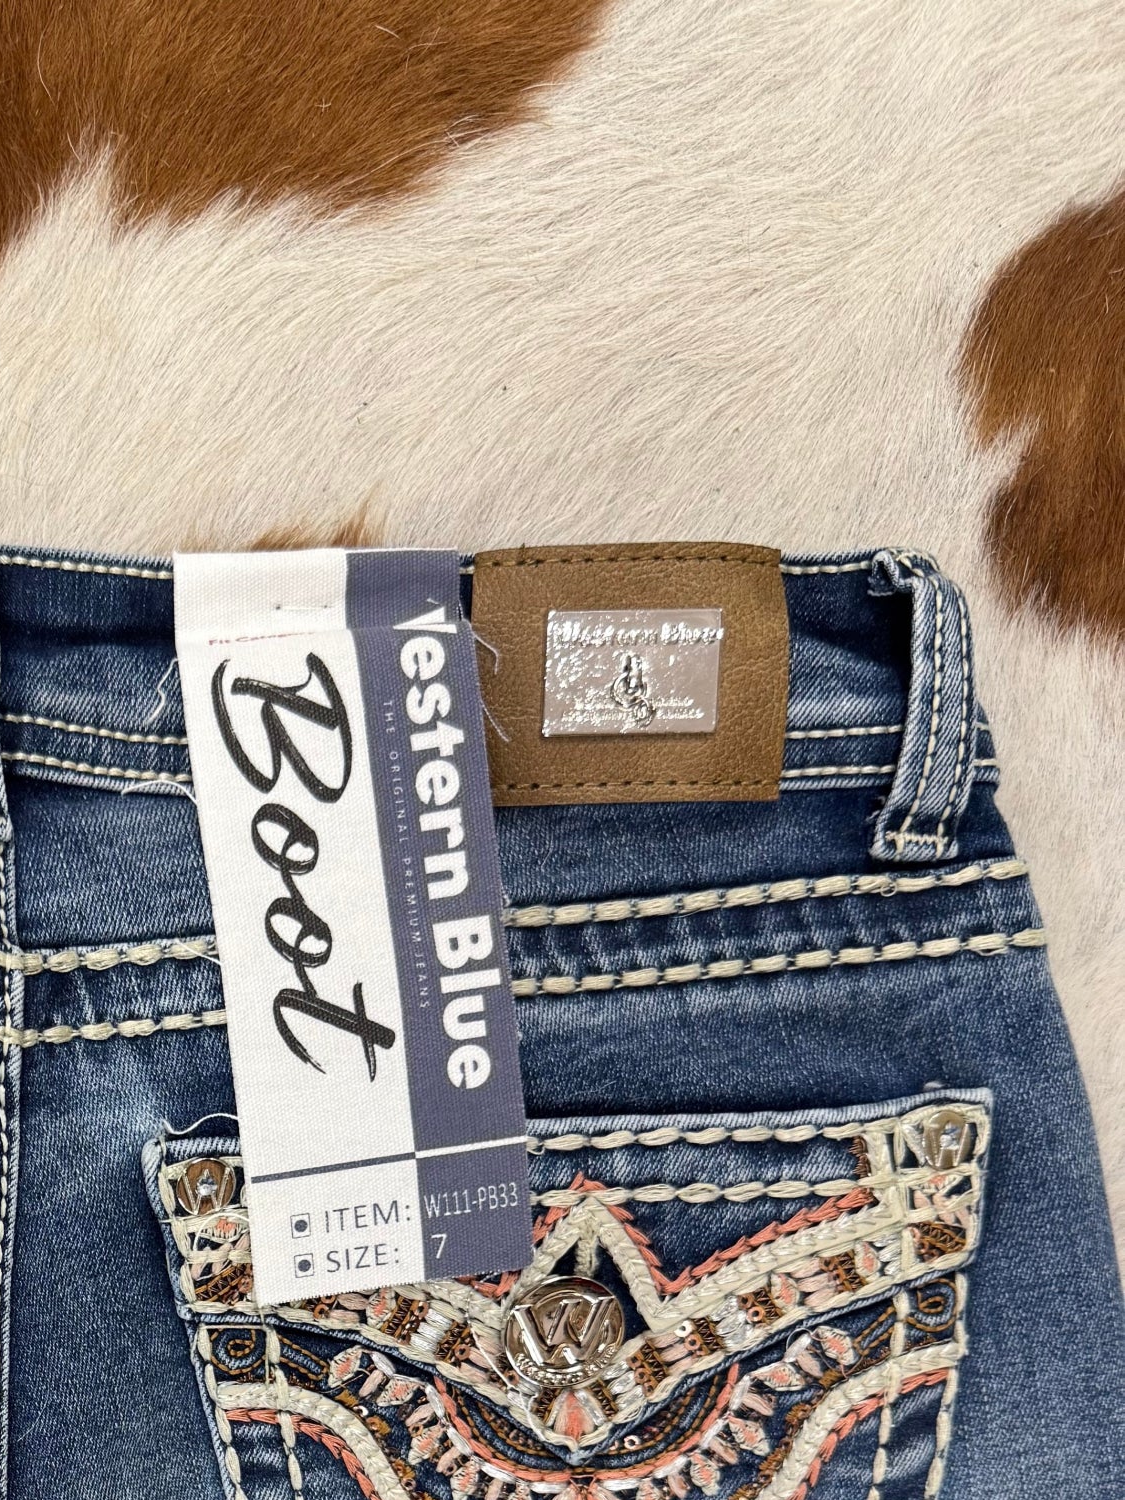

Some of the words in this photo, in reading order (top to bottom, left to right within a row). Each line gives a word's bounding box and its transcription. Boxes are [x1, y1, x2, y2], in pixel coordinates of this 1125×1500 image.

[383, 700, 396, 734] THE
[389, 751, 409, 842] ORIGINAL
[210, 652, 396, 1082] Boot
[402, 857, 422, 943] PREMIUM
[415, 952, 430, 1009] JEANS
[432, 914, 502, 1090] Blue
[325, 1200, 411, 1233] ITEM:
[423, 1182, 519, 1219] W111-PB33
[326, 1243, 400, 1273] SIZE:
[431, 1233, 448, 1260] 7
